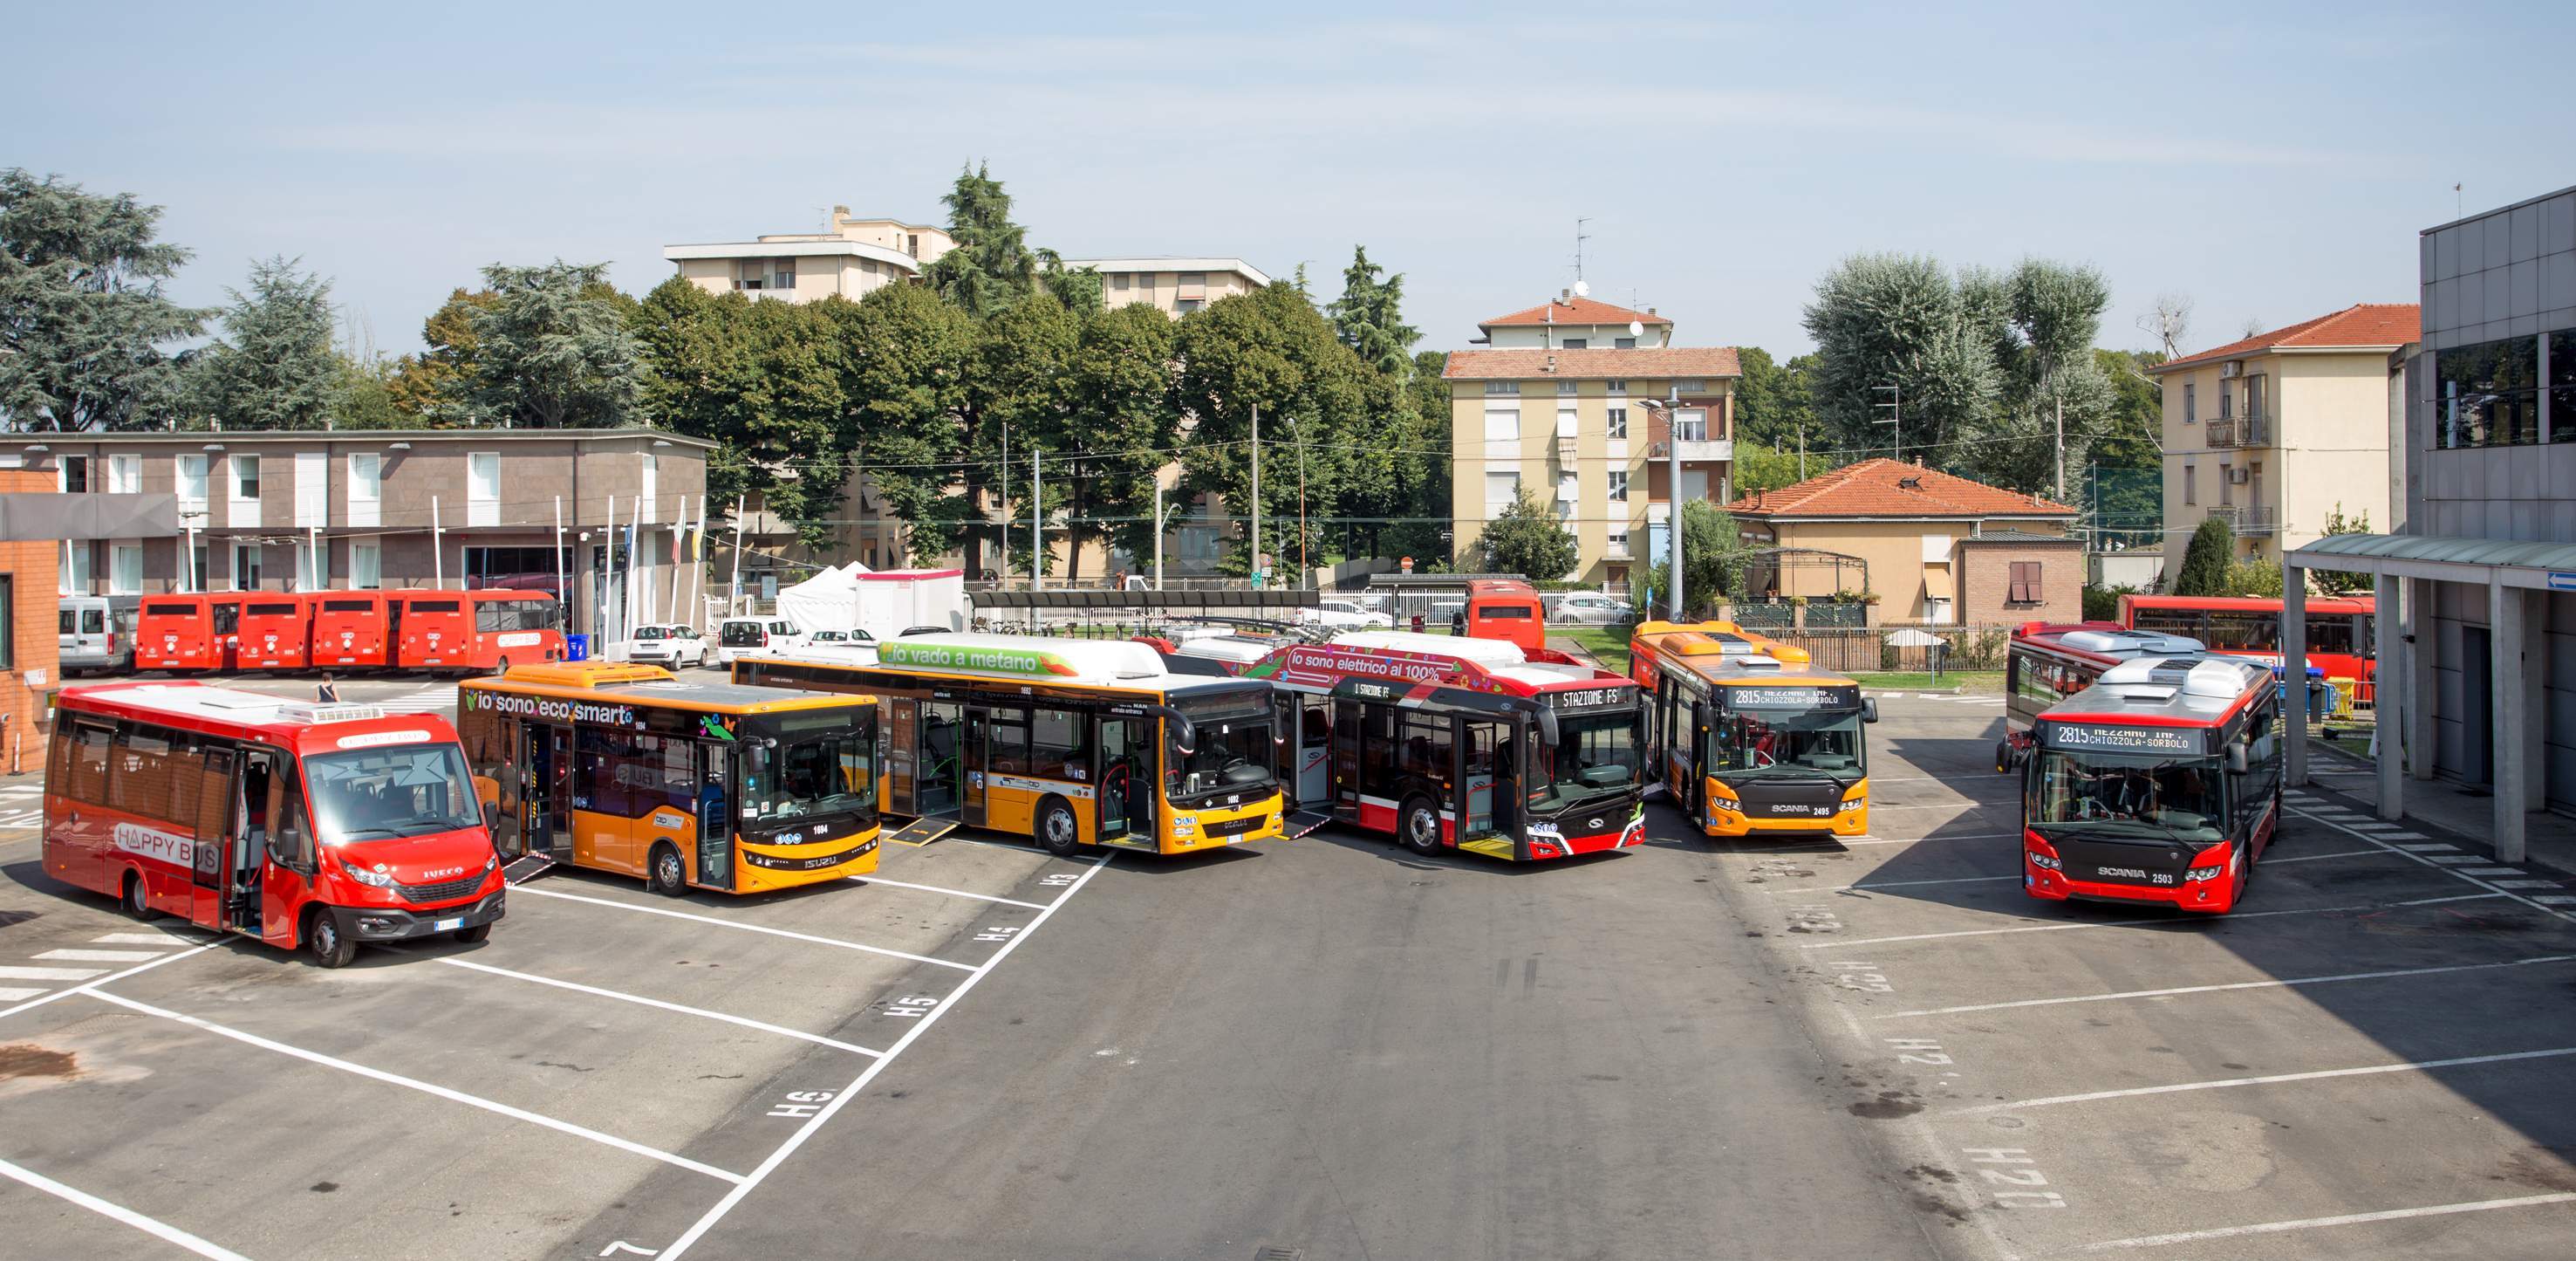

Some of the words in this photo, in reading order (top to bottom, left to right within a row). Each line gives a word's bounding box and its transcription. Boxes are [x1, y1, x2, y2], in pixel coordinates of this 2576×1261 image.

[893, 646, 906, 659] io
[912, 648, 950, 664] vado
[955, 652, 966, 663] a
[971, 653, 1035, 671] metano
[1292, 652, 1302, 664] io
[1305, 655, 1334, 668] sono
[1337, 657, 1387, 675] elettrico
[1390, 664, 1402, 676] al
[1404, 665, 1439, 682] 100%
[1360, 684, 1382, 696] STAZIONE
[1735, 690, 1760, 703] 2815
[1549, 694, 1554, 708] 1
[1563, 691, 1602, 707] STAZIONE
[1607, 689, 1617, 703] FS
[478, 691, 492, 709] io
[496, 696, 535, 714] sono
[539, 701, 568, 717] eco
[575, 703, 625, 724] smart
[2059, 726, 2089, 743] 2815
[2090, 737, 2189, 748] CHIOZZOLA-SORBOLO
[813, 825, 829, 835] 1694
[118, 827, 174, 857] HAPPY
[180, 843, 216, 867] BUS
[804, 856, 837, 868] ISUZU
[423, 866, 464, 880] IVECO
[1039, 874, 1079, 886] H3
[2098, 867, 2147, 879] SCANIA
[2152, 874, 2172, 884] 2503
[973, 927, 1022, 942] H4
[883, 997, 939, 1018] H5
[766, 1091, 834, 1118] H6
